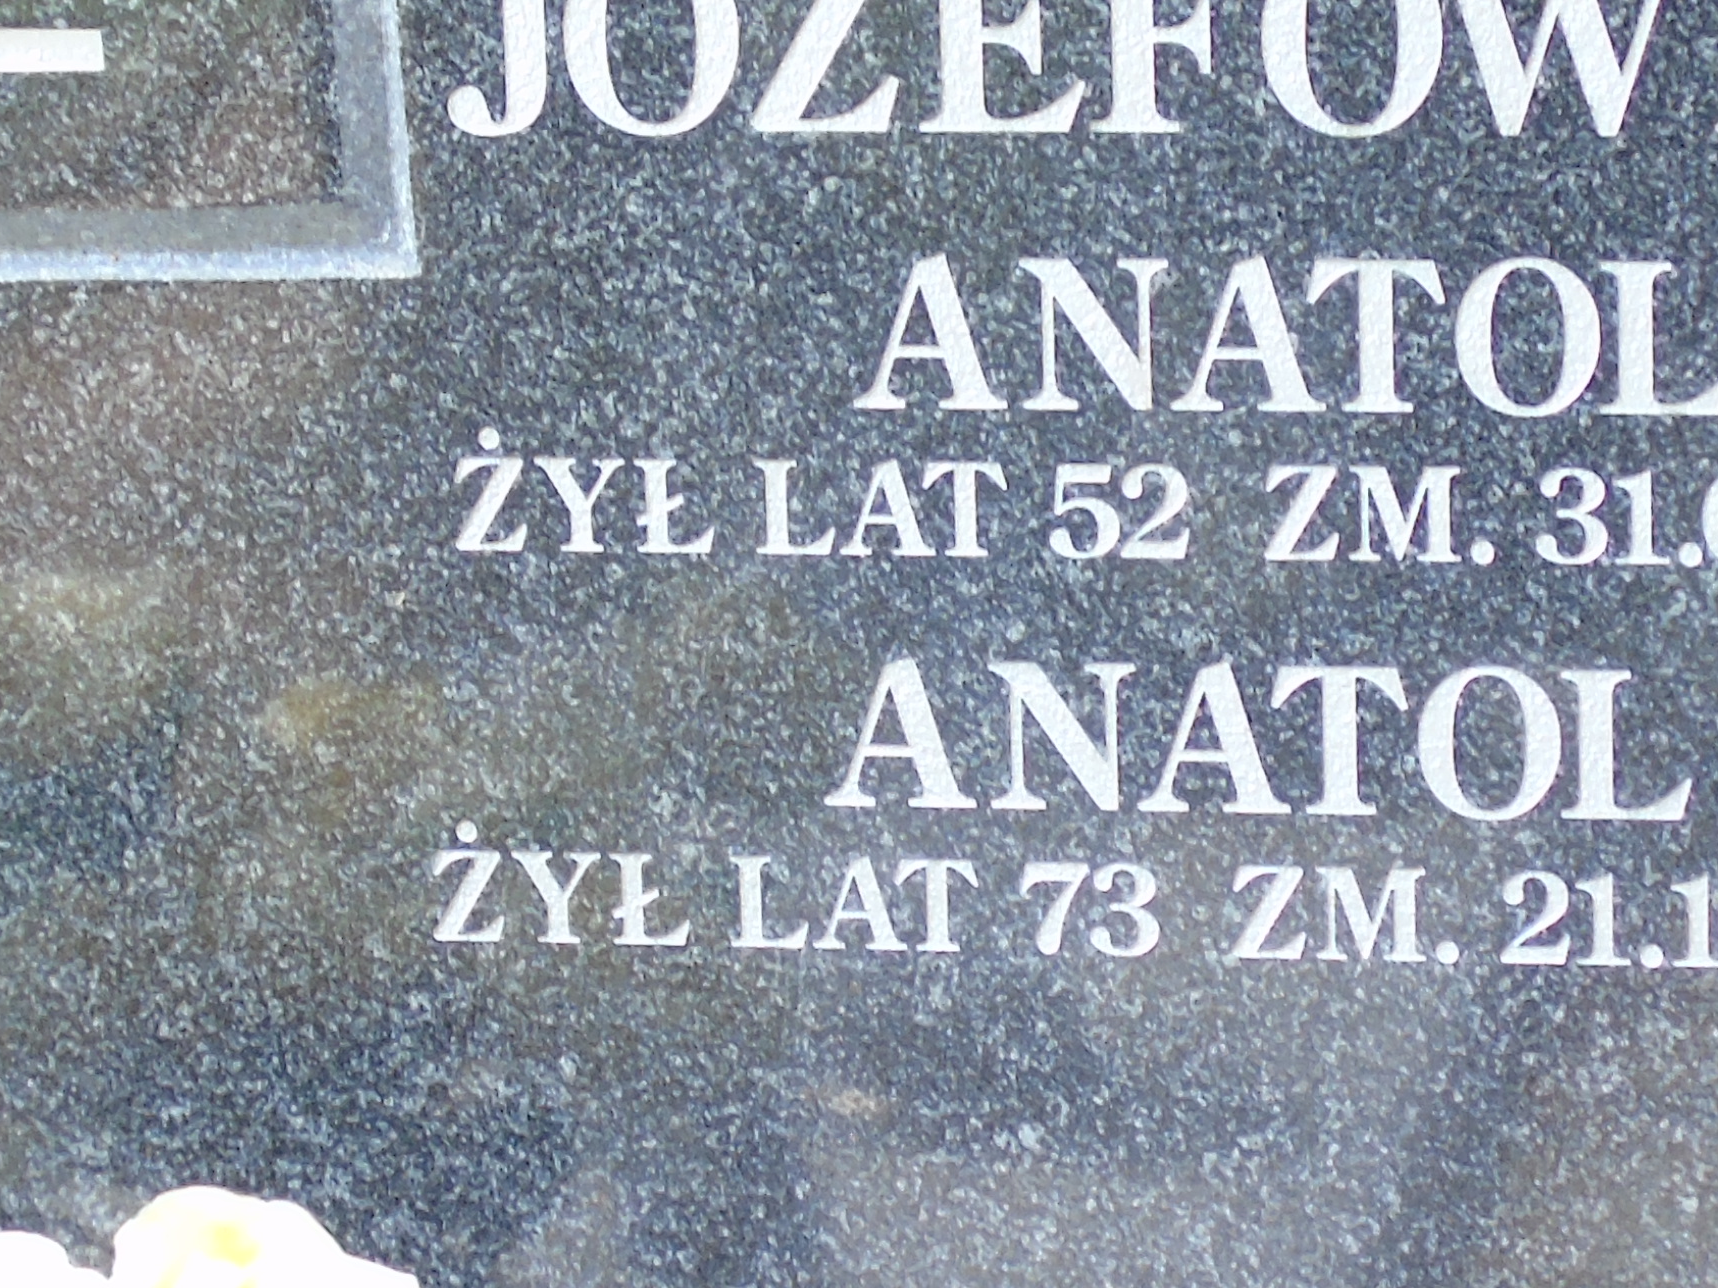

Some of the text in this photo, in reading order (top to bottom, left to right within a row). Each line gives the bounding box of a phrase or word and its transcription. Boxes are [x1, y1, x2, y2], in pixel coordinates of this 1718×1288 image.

[453, 426, 715, 555] ŻYŁ
[753, 459, 1009, 558] LAT
[1048, 463, 1192, 561] 52
[1263, 464, 1497, 564] ZM.
[823, 655, 1693, 822] ANATOL
[430, 818, 691, 947] ŻYŁ
[729, 854, 980, 954] LAT
[1018, 860, 1161, 958] 73
[1231, 863, 1461, 966] ZM.
